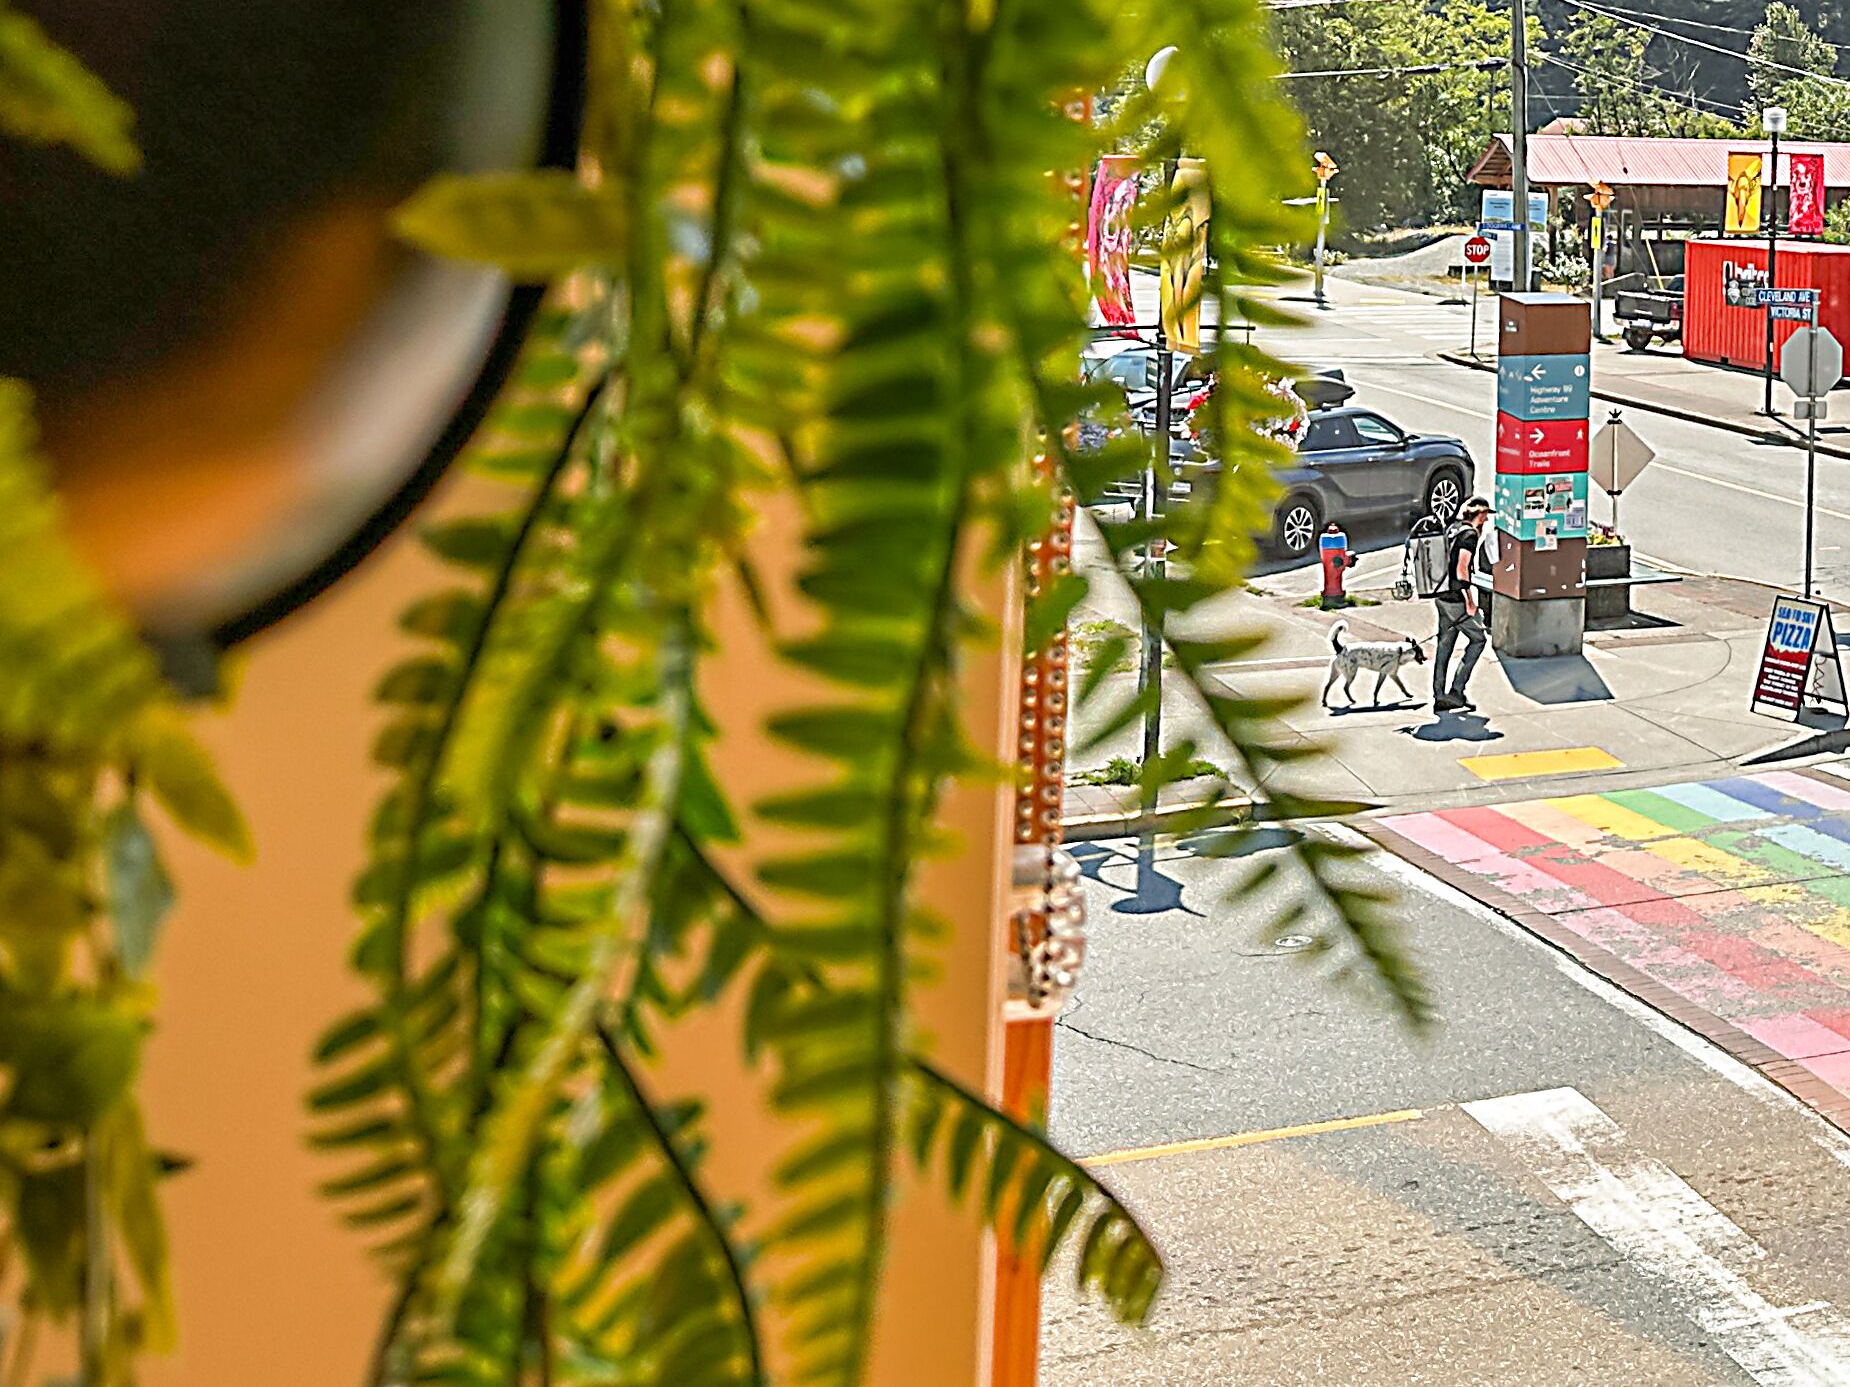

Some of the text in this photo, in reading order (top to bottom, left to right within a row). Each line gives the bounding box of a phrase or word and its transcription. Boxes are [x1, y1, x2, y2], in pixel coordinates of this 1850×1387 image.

[1466, 244, 1490, 255] STOP
[1758, 291, 1797, 302] CLEVELAND
[1798, 291, 1811, 303] AVE
[1770, 306, 1812, 319] VICTORIA ST
[1530, 395, 1569, 403] Adventure
[1529, 405, 1556, 414] Centre
[1528, 448, 1571, 458] Oceanfront
[1778, 606, 1816, 625] SEA TO SKY
[1772, 621, 1812, 650] PIZZA
